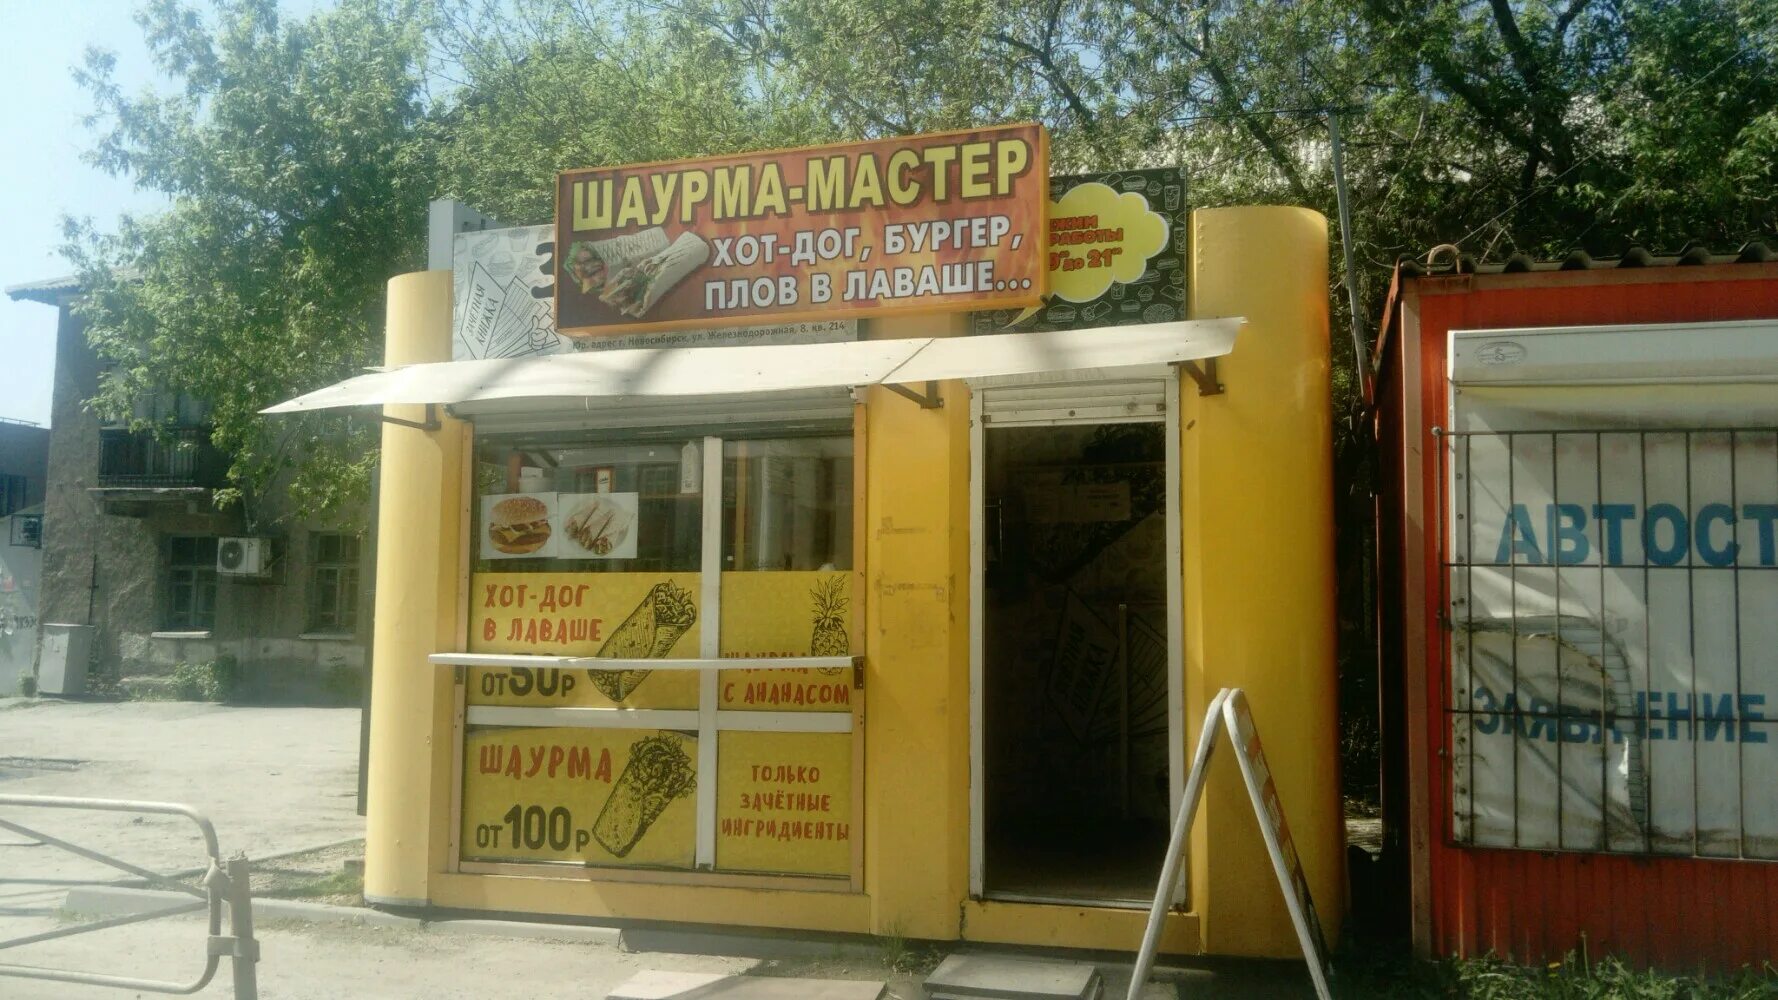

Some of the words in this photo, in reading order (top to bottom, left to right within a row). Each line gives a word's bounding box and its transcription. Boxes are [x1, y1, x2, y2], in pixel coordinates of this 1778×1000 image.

[572, 138, 1028, 232] ШАУРМА-МАСТЕР
[711, 226, 872, 267] ХОТ-ДОГ,
[884, 215, 1024, 255] БУРГЕР,
[704, 275, 798, 311] ПЛОВ
[810, 272, 833, 304] В
[842, 259, 1032, 302] ЛАВАШЕ...
[828, 321, 845, 331] 214
[484, 584, 590, 613] ХОТ-ДОГ
[483, 617, 497, 642] В
[506, 617, 603, 645] ЛАВАШЕ
[723, 682, 735, 703] С
[743, 681, 850, 706] АНАНАСОМ
[479, 744, 613, 785] ШАУРМА
[751, 765, 820, 785] ТОЛЬКО
[739, 789, 832, 812] ЗАЧЁТНЫЕ
[721, 817, 850, 842] ИНГРИДИЕНТЫ
